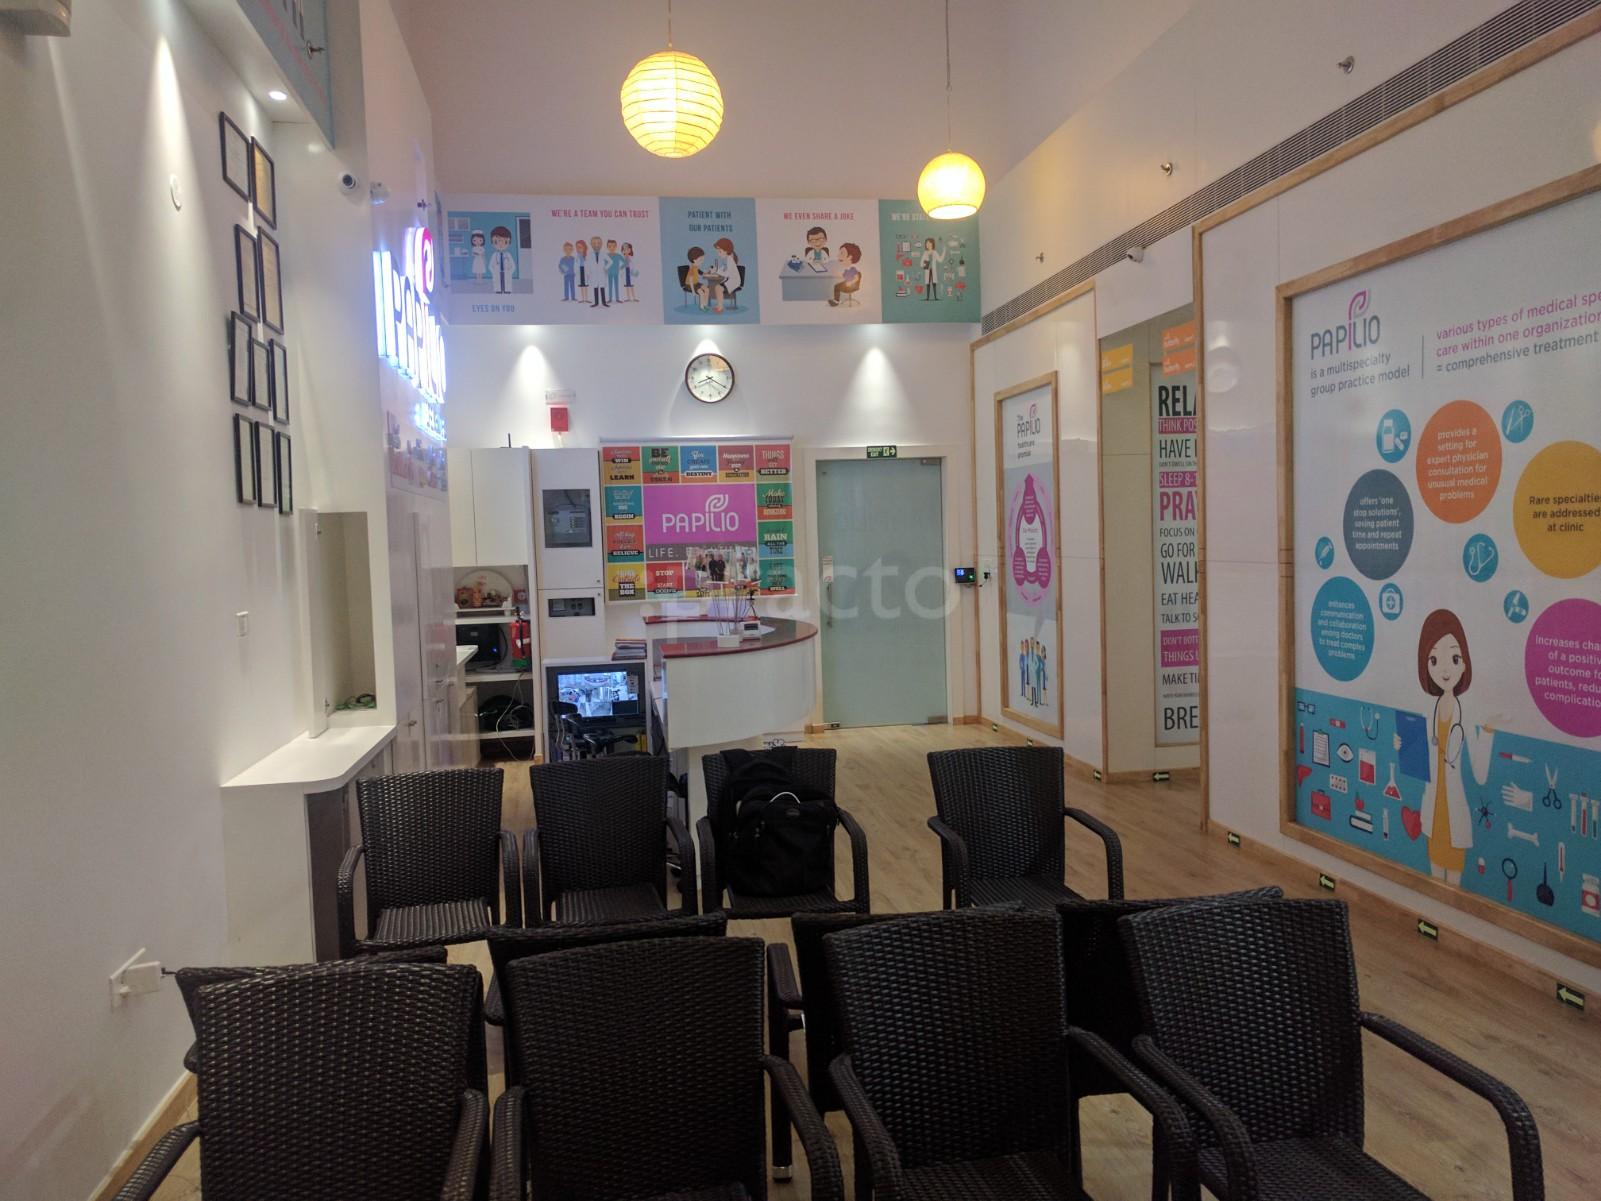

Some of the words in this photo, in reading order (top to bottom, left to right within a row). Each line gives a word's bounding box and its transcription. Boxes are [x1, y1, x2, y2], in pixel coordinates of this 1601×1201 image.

[580, 210, 598, 218] TEAM
[600, 210, 613, 218] YOU
[614, 210, 628, 218] CAN
[629, 210, 648, 218] TRUST
[688, 210, 712, 218] PATIENT
[812, 212, 832, 220] SHARE
[704, 224, 732, 232] PATIENTS
[1436, 321, 1474, 340] various
[1476, 313, 1508, 332] types
[1511, 307, 1524, 322] of
[1527, 293, 1577, 318] medical
[1310, 314, 1380, 360] PAPILIO
[1436, 343, 1459, 358] care
[1461, 335, 1494, 352] within
[1498, 328, 1520, 344] one
[1445, 346, 1530, 372] comprehensive
[1532, 330, 1599, 355] treatment
[1310, 368, 1318, 380] is
[1326, 352, 1392, 376] multispecialty
[1310, 382, 1336, 398] group
[1338, 374, 1376, 392] practice
[1378, 364, 1410, 382] model
[1158, 385, 1196, 416] REL
[1160, 418, 1182, 432] THINK
[1438, 428, 1470, 440] provides
[1160, 438, 1191, 458] HAVE
[1438, 441, 1464, 451] setting
[1466, 440, 1478, 448] for
[651, 448, 669, 457] BE
[1427, 453, 1450, 464] expert
[1452, 450, 1488, 464] physician
[1428, 464, 1474, 476] consultation
[1475, 463, 1488, 472] for
[1160, 472, 1184, 486] SLEEP
[1428, 477, 1456, 488] unusual
[1457, 476, 1488, 487] medical
[1440, 489, 1474, 501] problems
[1529, 496, 1550, 504] Rare
[1160, 491, 1197, 520] PRA
[1550, 507, 1601, 518] addressed
[662, 511, 739, 533] PAPILIO
[1376, 519, 1400, 528] patient
[1547, 523, 1556, 531] at
[1559, 522, 1584, 531] clinic
[1160, 528, 1182, 537] FOCUS
[1184, 528, 1194, 536] ON
[1352, 530, 1366, 538] time
[1368, 530, 1379, 538] and
[1380, 530, 1402, 539] repeat
[1160, 543, 1174, 558] GO
[1176, 542, 1195, 558] FOR
[1356, 542, 1399, 550] appointments
[1162, 592, 1178, 606] EAT
[1160, 613, 1180, 624] TALK
[1180, 612, 1191, 623] TO
[1535, 634, 1579, 649] Increases
[1163, 651, 1194, 662] THINGS
[1548, 650, 1558, 660] of
[1548, 665, 1591, 678] outcome
[1162, 673, 1188, 685] MAKE
[1535, 676, 1576, 692] patients,
[1164, 706, 1198, 730] BRE
